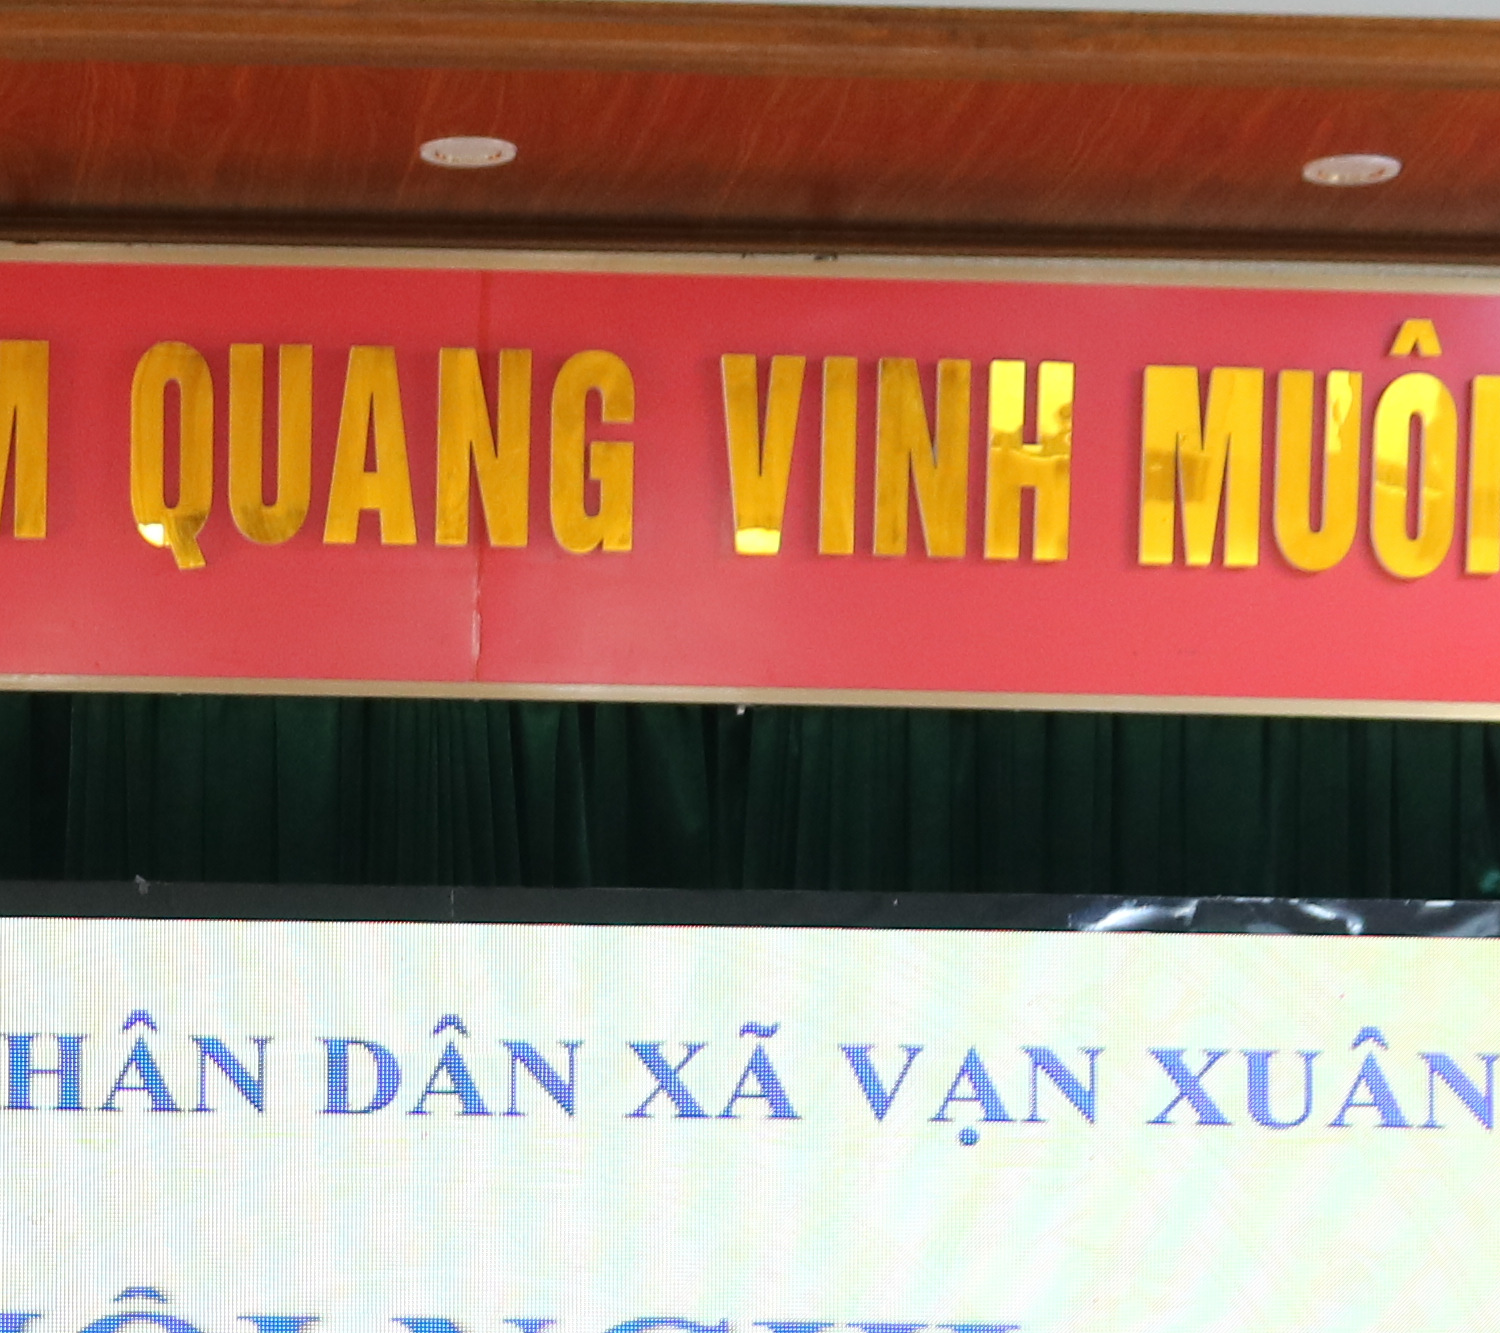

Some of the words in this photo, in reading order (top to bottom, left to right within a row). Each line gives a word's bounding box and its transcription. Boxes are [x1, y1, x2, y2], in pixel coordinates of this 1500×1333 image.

[129, 341, 636, 570] QUANG
[721, 353, 1077, 563] VINH
[319, 1013, 581, 1118] DÂN
[625, 1019, 800, 1121] XÃ
[840, 1043, 1104, 1147] VẠN
[1146, 1024, 1500, 1131] XUÂN
